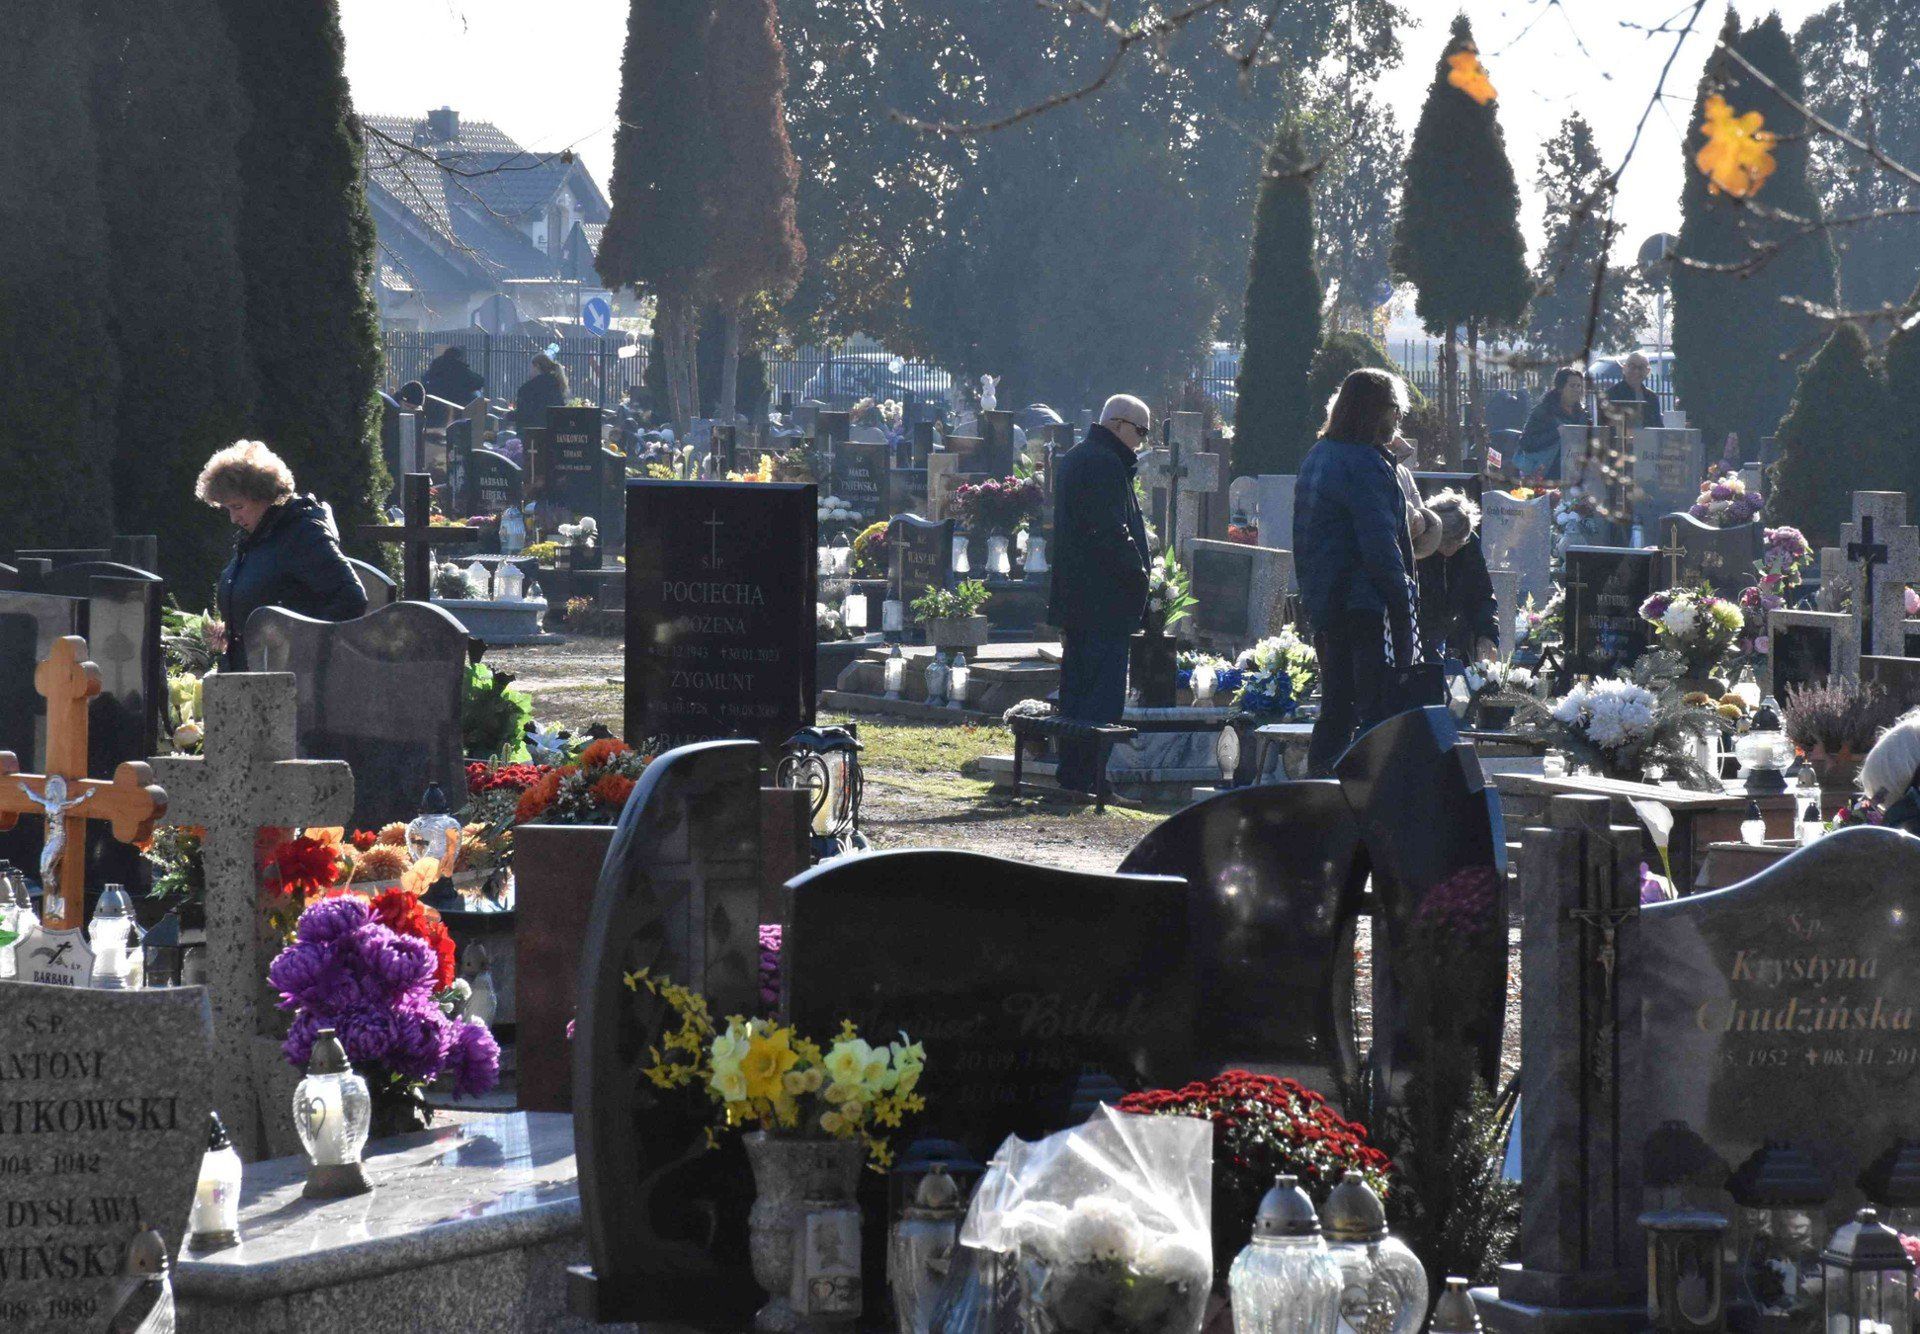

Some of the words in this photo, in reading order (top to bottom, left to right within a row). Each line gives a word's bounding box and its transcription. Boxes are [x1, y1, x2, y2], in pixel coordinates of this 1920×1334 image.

[661, 581, 766, 606] POCIECHA
[679, 614, 747, 635] OŻENA
[670, 670, 756, 691] ZYGMUNT
[33, 970, 75, 986] BARBARA
[1731, 949, 1878, 989] Krystyna
[1696, 995, 1913, 1034] Chudzińska
[0, 1051, 105, 1080] NTONI
[1886, 1049, 1920, 1066] 201
[0, 1097, 178, 1134] TKOWSKI
